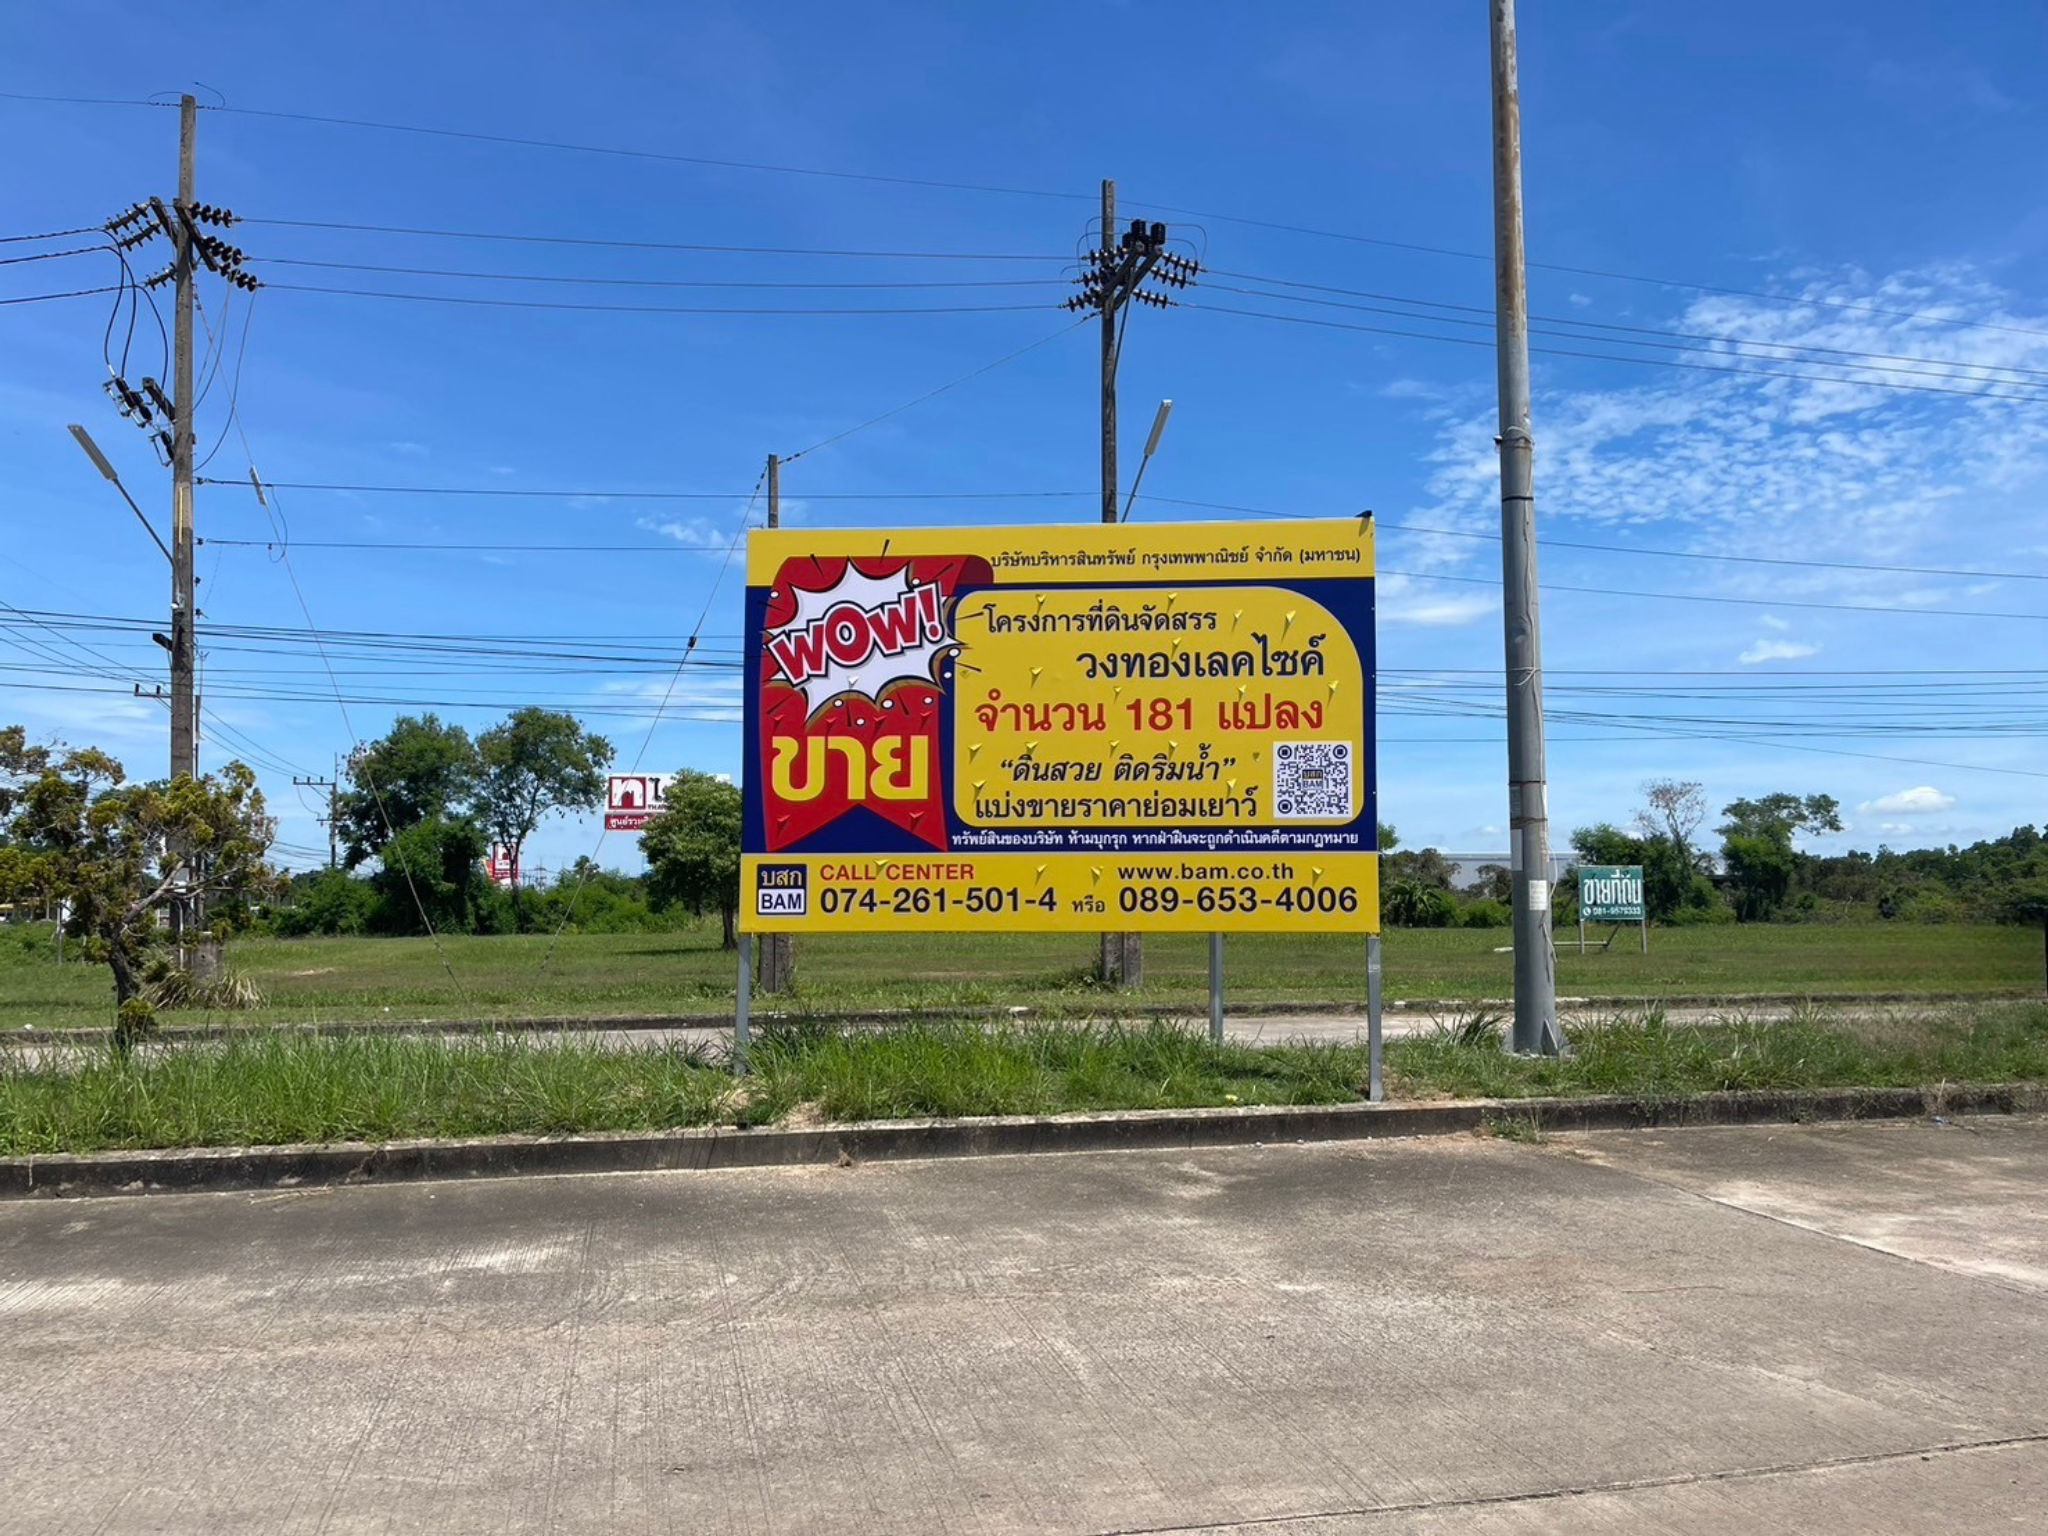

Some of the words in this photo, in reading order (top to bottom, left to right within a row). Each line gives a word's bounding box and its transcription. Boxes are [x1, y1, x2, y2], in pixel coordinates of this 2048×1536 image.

[990, 549, 1136, 568] บริษัทบริหารสินทรัพย์
[1141, 546, 1250, 570] กรุงเทพพาณิชย์
[1255, 546, 1293, 563] จำกัด
[1299, 548, 1361, 564] (มหาชน)
[982, 600, 1217, 633] โครงการที่ดินจัดสรร
[766, 582, 941, 687] WOW!
[975, 689, 1107, 732] จำนวน
[1126, 697, 1194, 731] 181
[1218, 694, 1324, 730] แปลง
[771, 734, 929, 801] ขาย
[975, 786, 1258, 818] แบ่งขายราคาย่อมเยาว์
[952, 830, 1063, 846] ทรัพย์สินของบริษัท
[1068, 830, 1128, 850] ห้ามบุกรุก
[761, 869, 802, 886] บสก
[820, 864, 877, 881] CALL
[885, 864, 975, 880] CENTER
[1118, 863, 1294, 880] www.bam.co.th
[761, 893, 802, 909] BAM
[820, 887, 1057, 913] 074-261-501-4
[1072, 894, 1105, 912] หรือ
[1119, 886, 1358, 912] 089-653-4006
